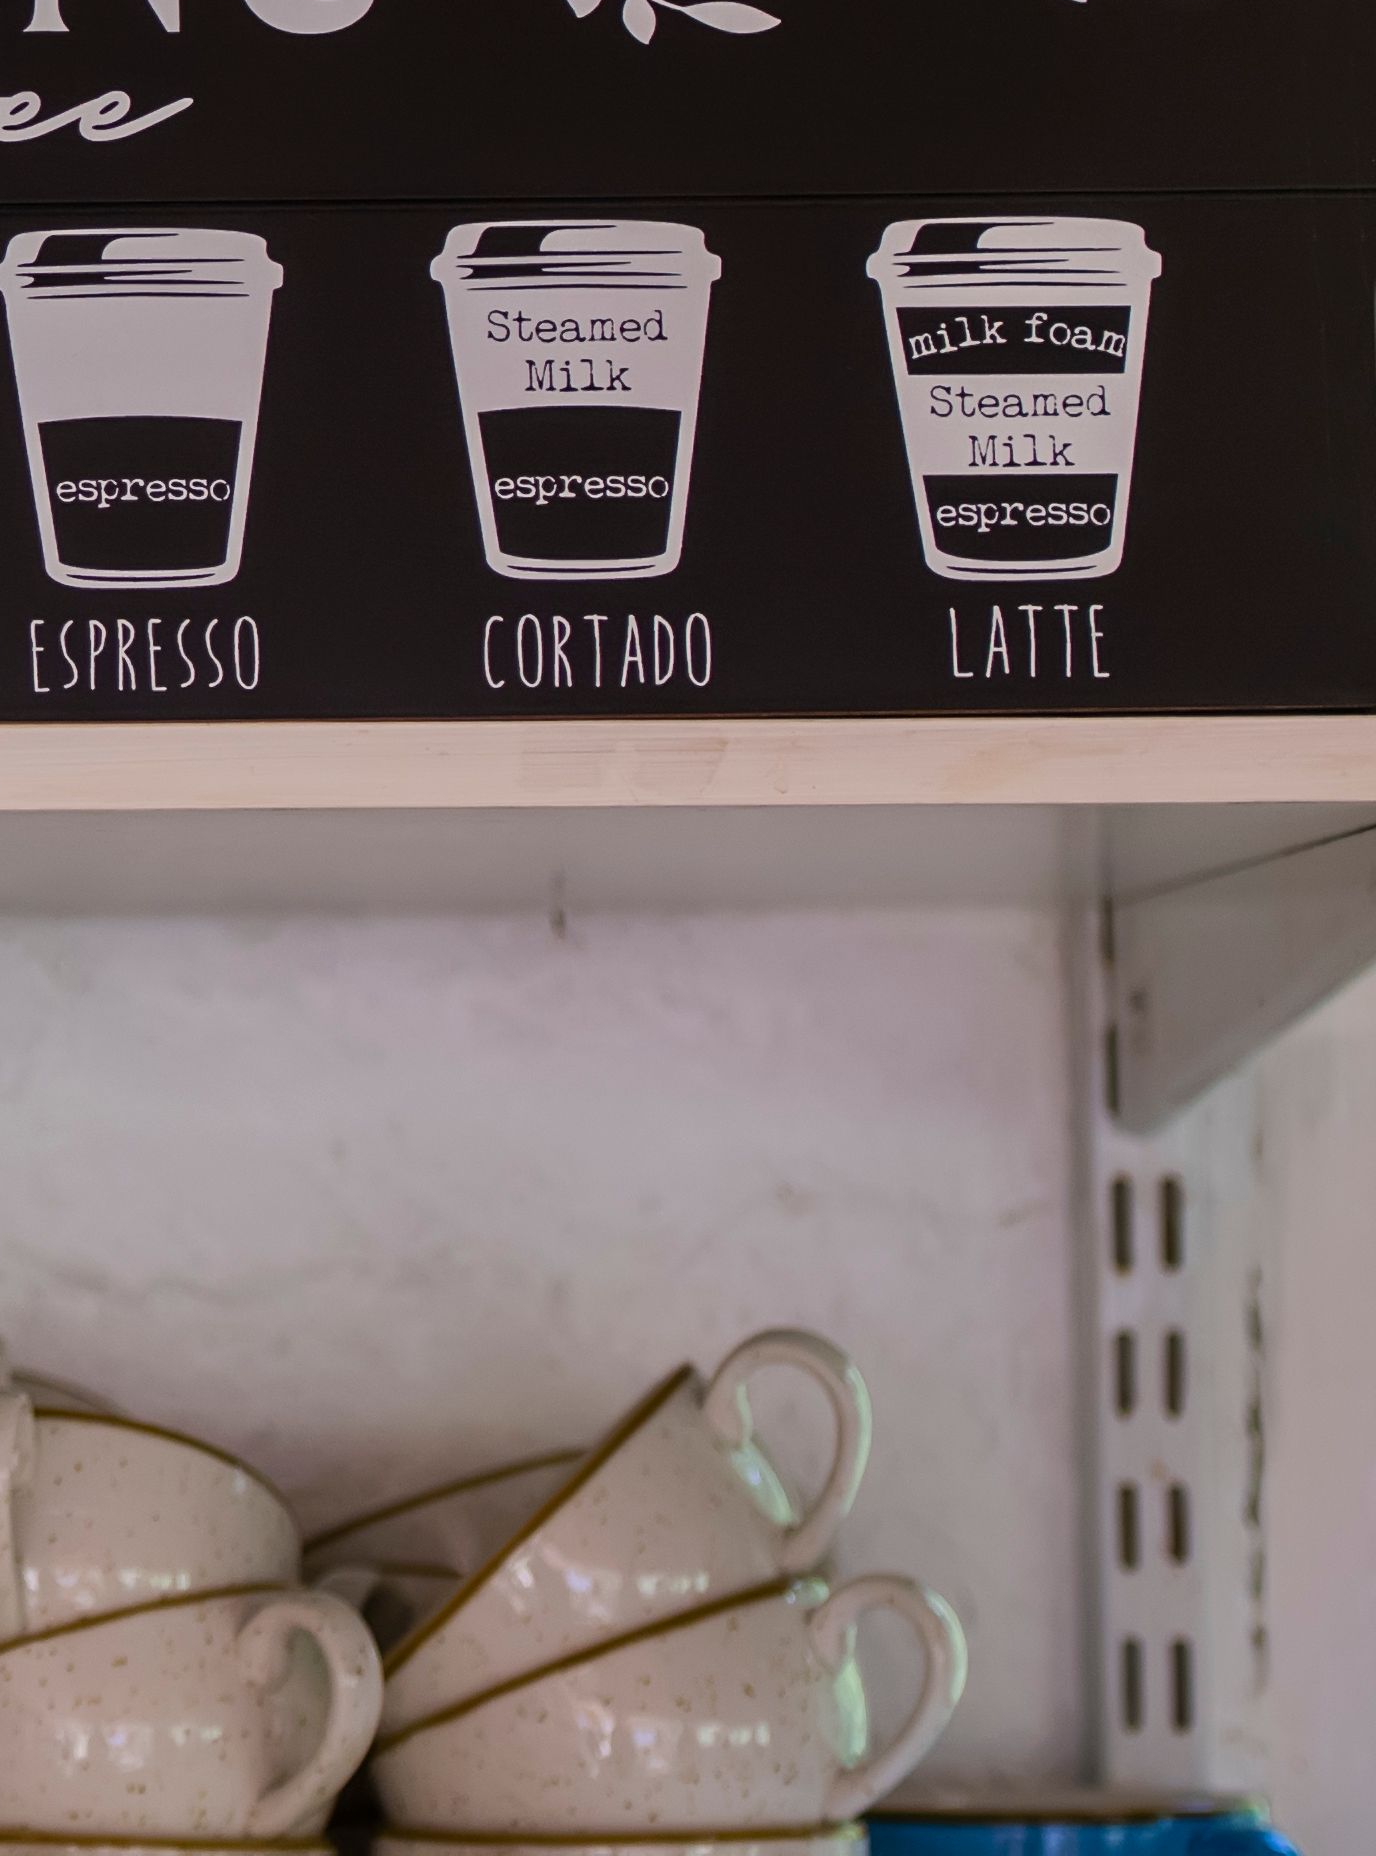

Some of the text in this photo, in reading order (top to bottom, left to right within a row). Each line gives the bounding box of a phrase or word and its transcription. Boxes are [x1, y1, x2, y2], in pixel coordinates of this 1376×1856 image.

[486, 309, 668, 343] Steamed
[909, 314, 1126, 360] milk foam
[524, 359, 632, 393] Milk
[929, 384, 1111, 419] Steamed
[968, 434, 1075, 469] Milk
[56, 475, 231, 508] espresso
[494, 471, 670, 505] espresso
[936, 500, 1111, 534] espresso
[30, 616, 260, 694] ESPRESSO
[484, 612, 713, 690] CORTADO
[949, 604, 1111, 682] LATTE
